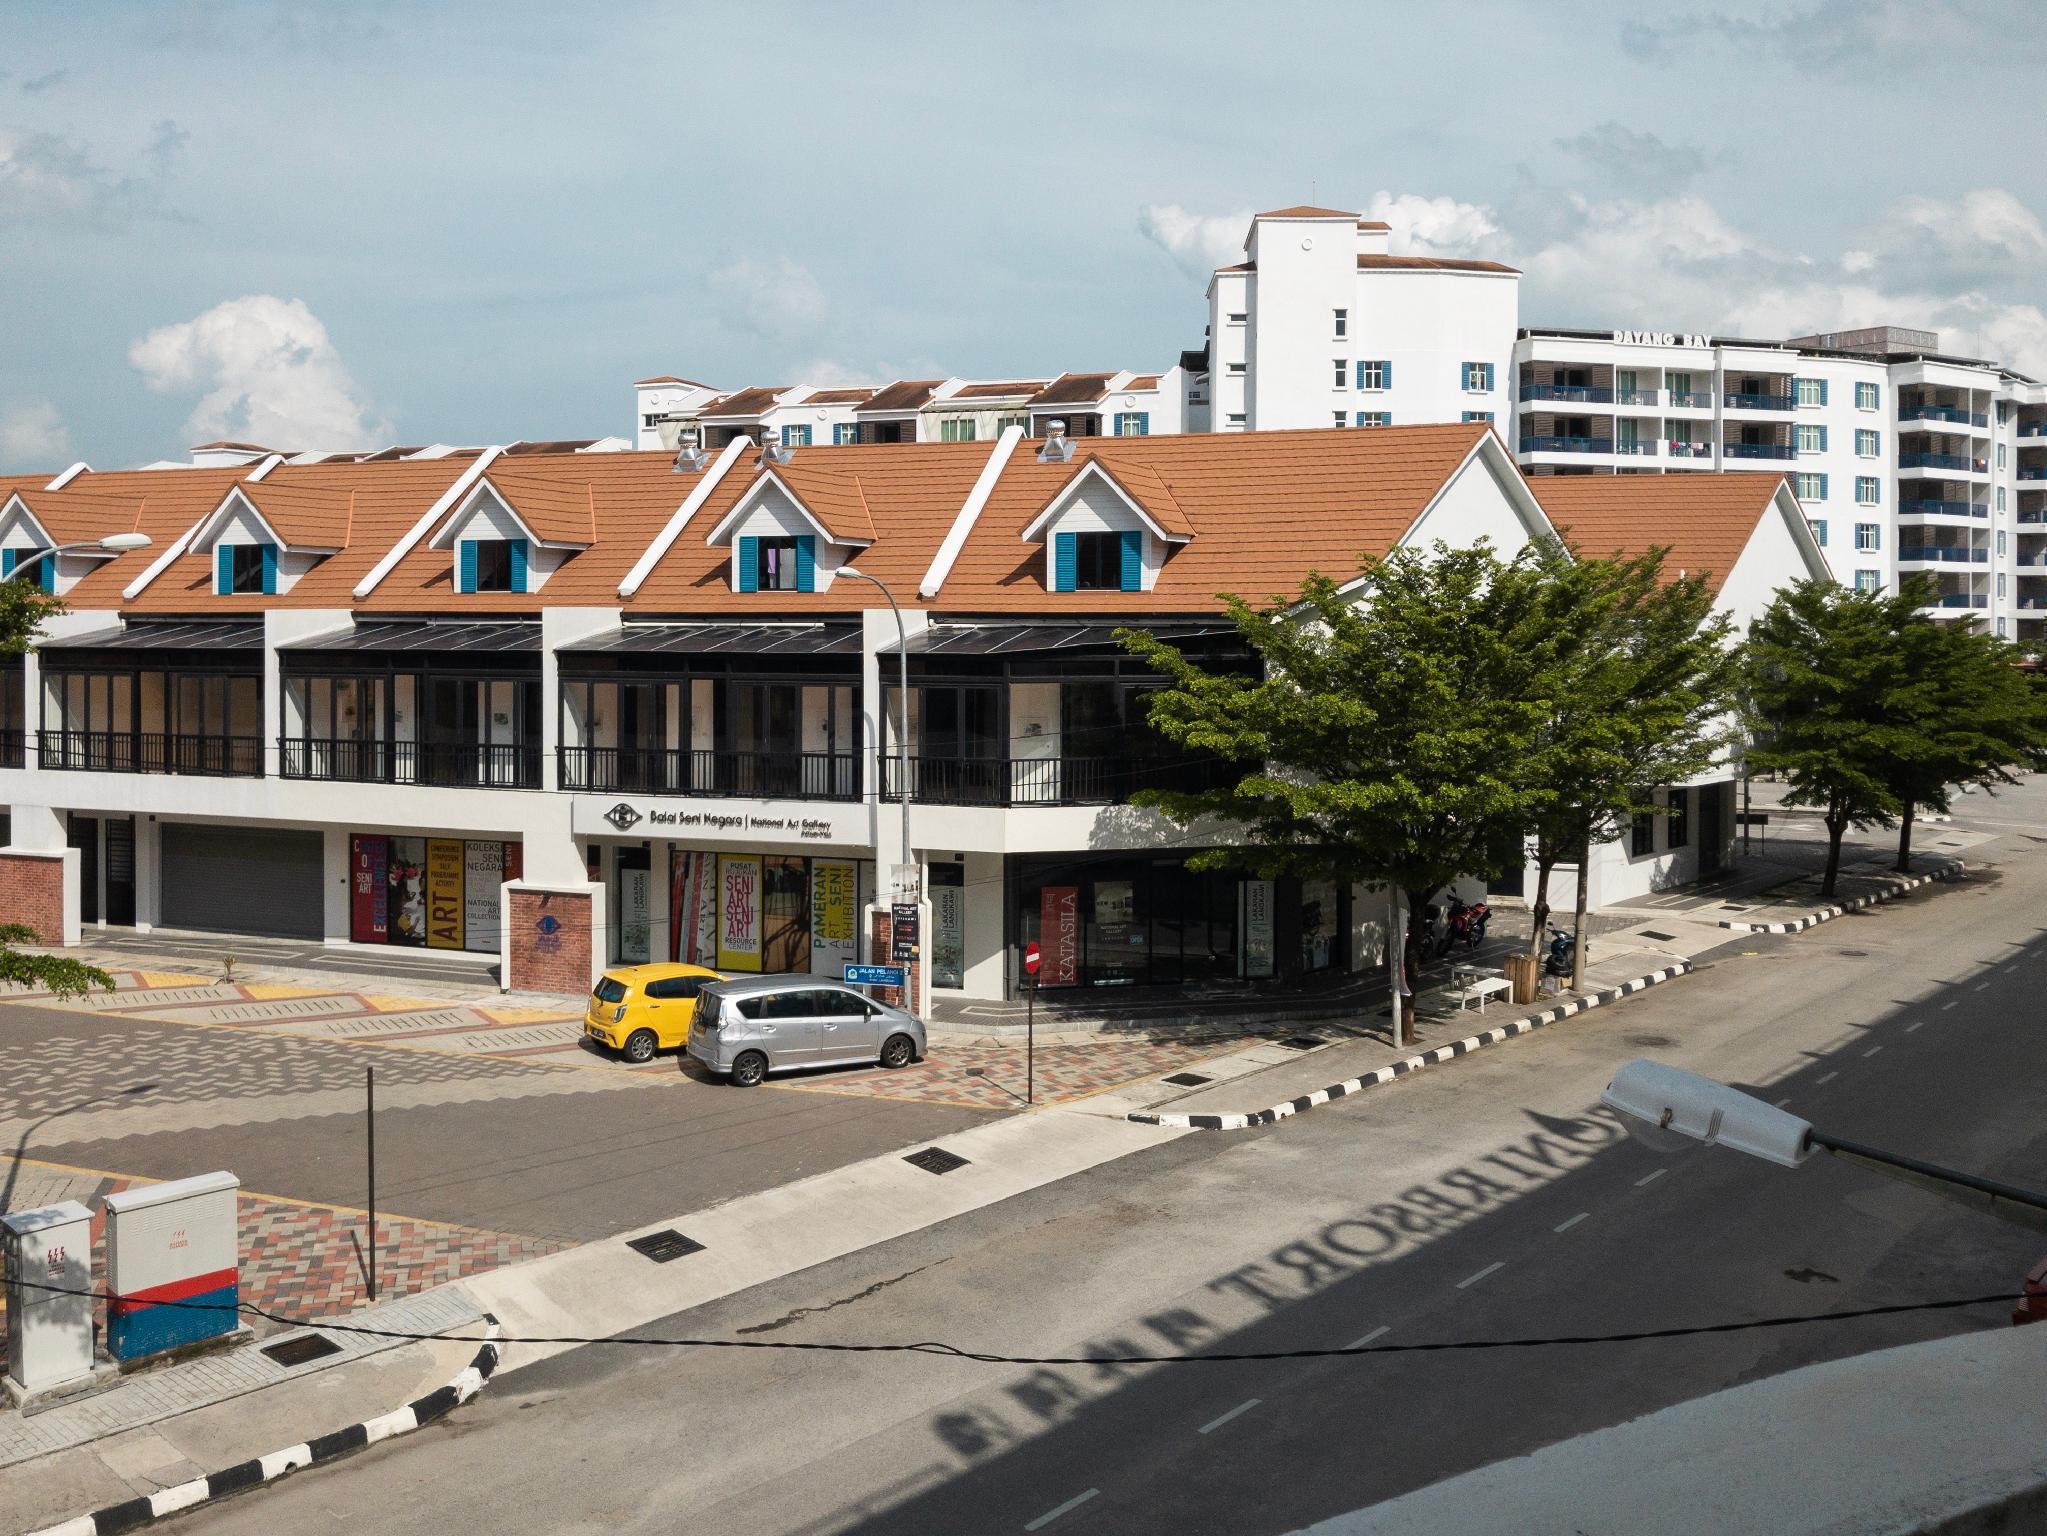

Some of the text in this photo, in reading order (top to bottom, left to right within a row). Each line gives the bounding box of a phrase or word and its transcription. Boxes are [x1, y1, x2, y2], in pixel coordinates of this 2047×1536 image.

[1613, 330, 1712, 348] DAYANG BAY
[650, 811, 832, 831] Balai Seni Negara National Art Gallery
[505, 844, 513, 867] SENI
[467, 863, 504, 872] NEGARA
[730, 862, 752, 870] PUSAT
[356, 873, 373, 884] SENI
[726, 875, 754, 892] SENI
[358, 884, 372, 894] ART
[728, 890, 752, 908] ART
[814, 867, 826, 948] PAMERAN
[829, 867, 842, 949] ART SENI
[433, 891, 458, 943] ART
[467, 912, 501, 921] COLLECTION
[488, 907, 501, 915] ART
[726, 905, 754, 923] SENI
[843, 868, 855, 949] EXHIBITION
[728, 921, 752, 938] ART
[1060, 892, 1075, 981] KATASILA
[725, 937, 757, 945] RESOURCE
